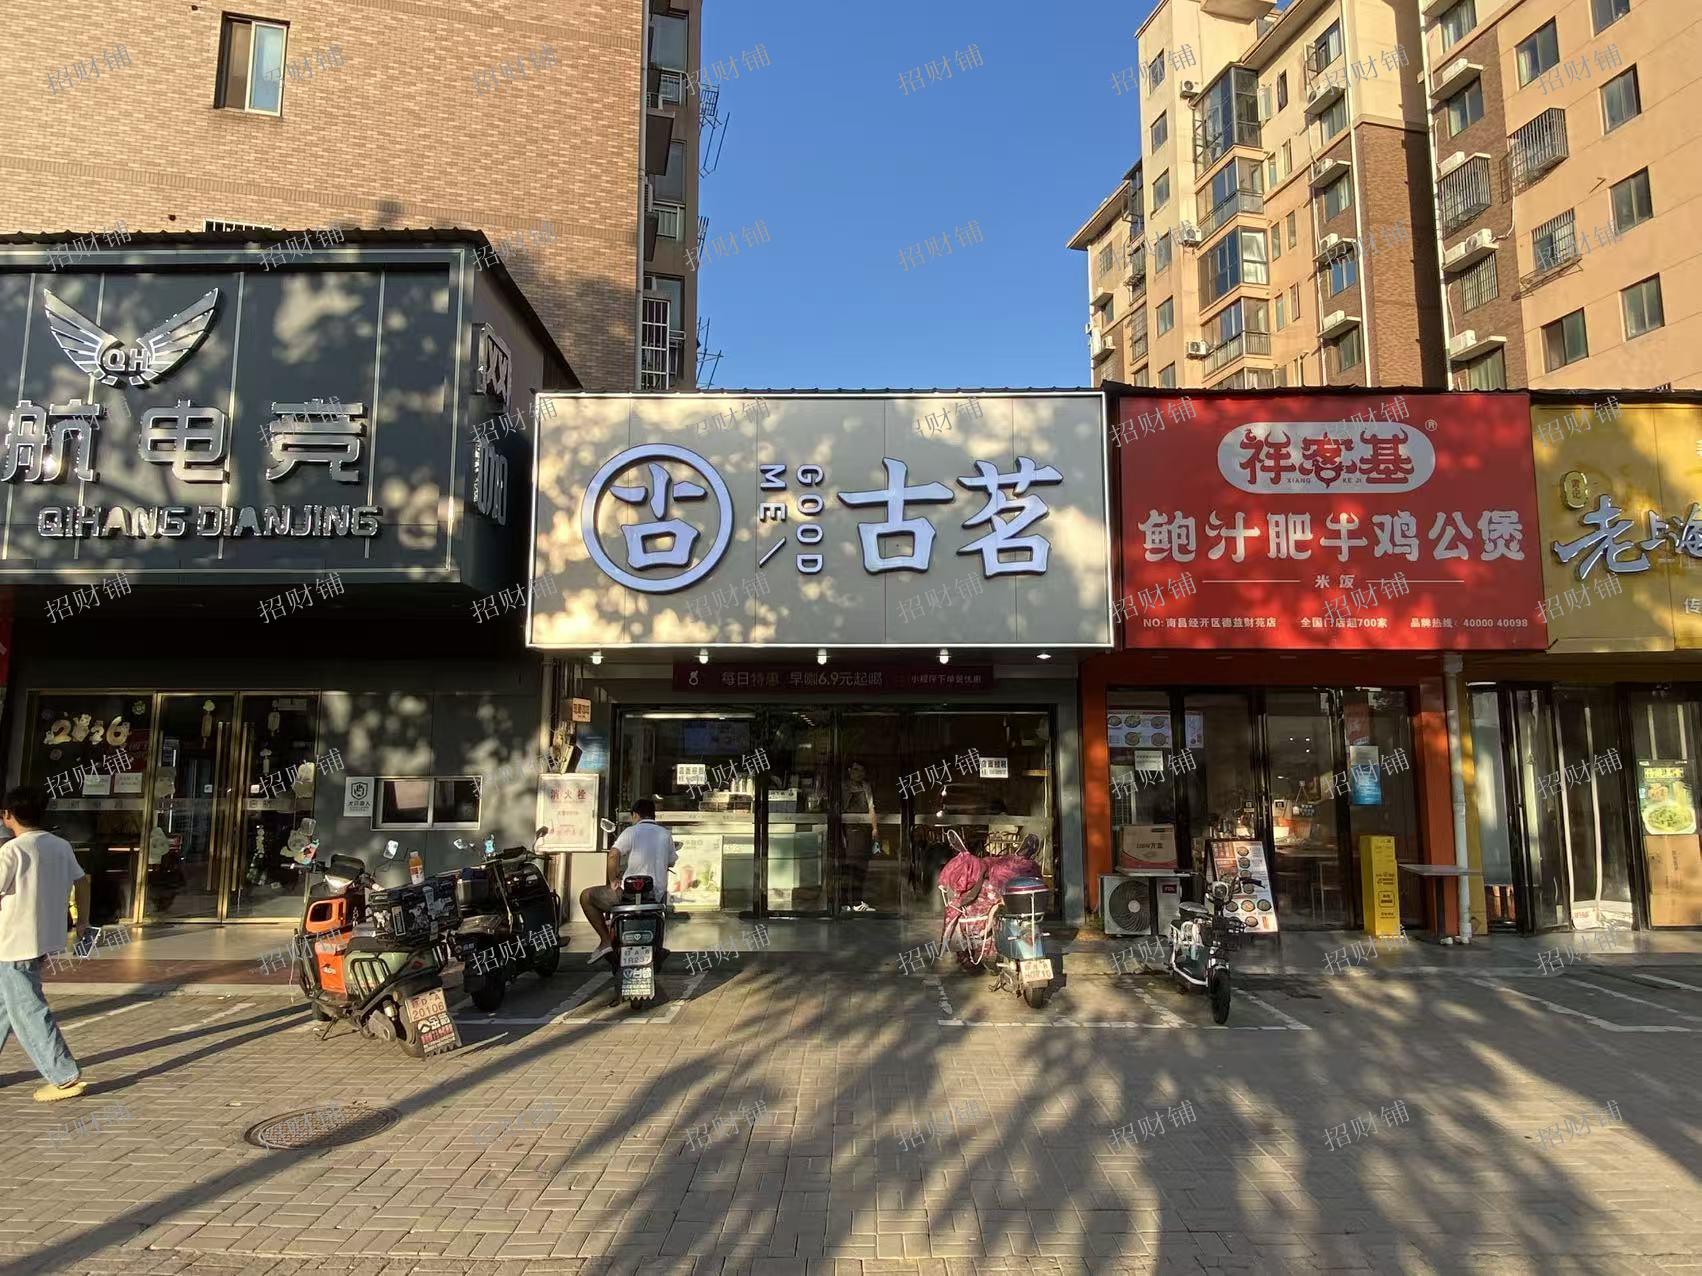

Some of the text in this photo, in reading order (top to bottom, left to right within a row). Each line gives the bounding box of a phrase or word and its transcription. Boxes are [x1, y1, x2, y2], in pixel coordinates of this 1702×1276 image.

[102, 348, 151, 372] QH
[1238, 428, 1416, 490] 祥客基
[38, 504, 382, 538] QIHANG DIANJING
[796, 464, 824, 575] GOOD
[837, 456, 1064, 577] 古茗
[1138, 509, 1526, 563] 鲍汁肥牛鸡公煲
[1315, 574, 1355, 590] 米饭
